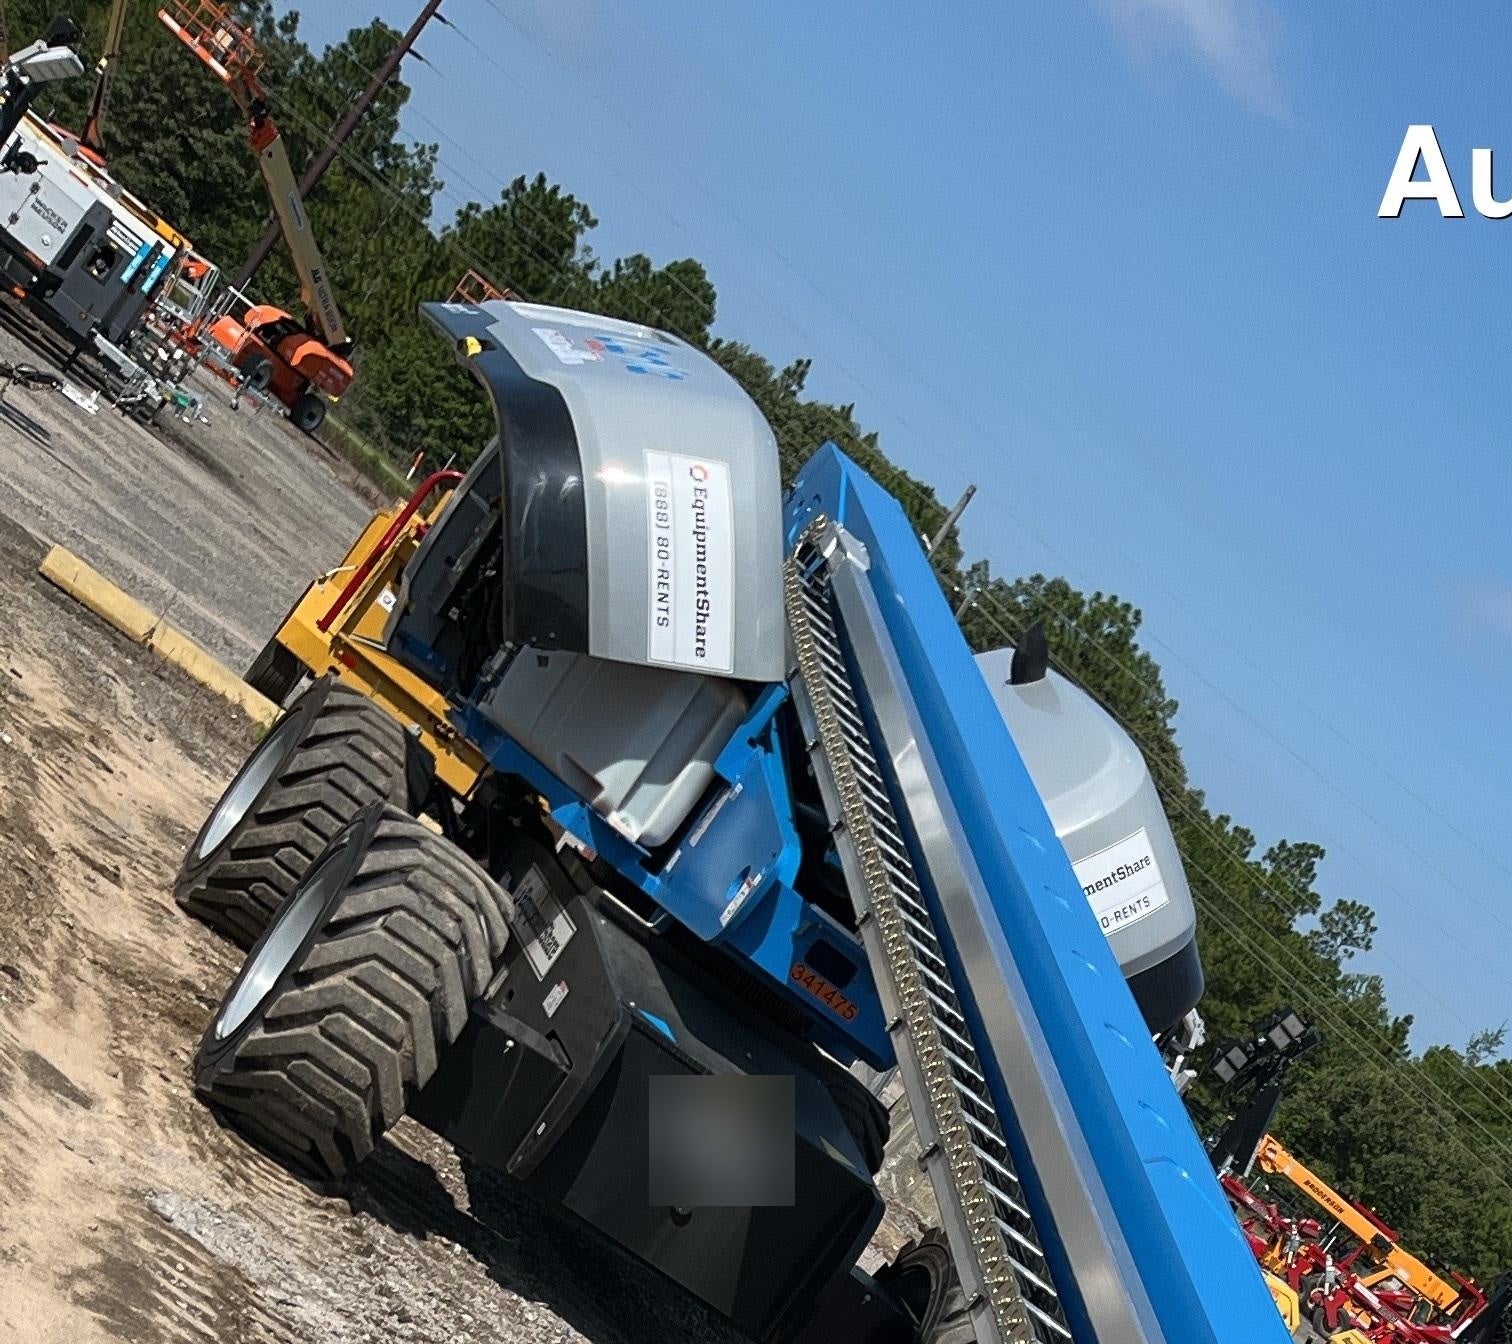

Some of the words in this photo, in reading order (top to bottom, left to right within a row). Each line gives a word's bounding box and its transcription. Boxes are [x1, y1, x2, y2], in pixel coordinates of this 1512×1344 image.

[656, 536, 671, 628] 80-RENTS
[691, 486, 710, 658] EquipmentShare
[1083, 855, 1151, 896] mentShare
[1101, 895, 1151, 929] 0-RENTS
[791, 964, 858, 1020] 341475
[1303, 1179, 1345, 1214] BRODERSON
